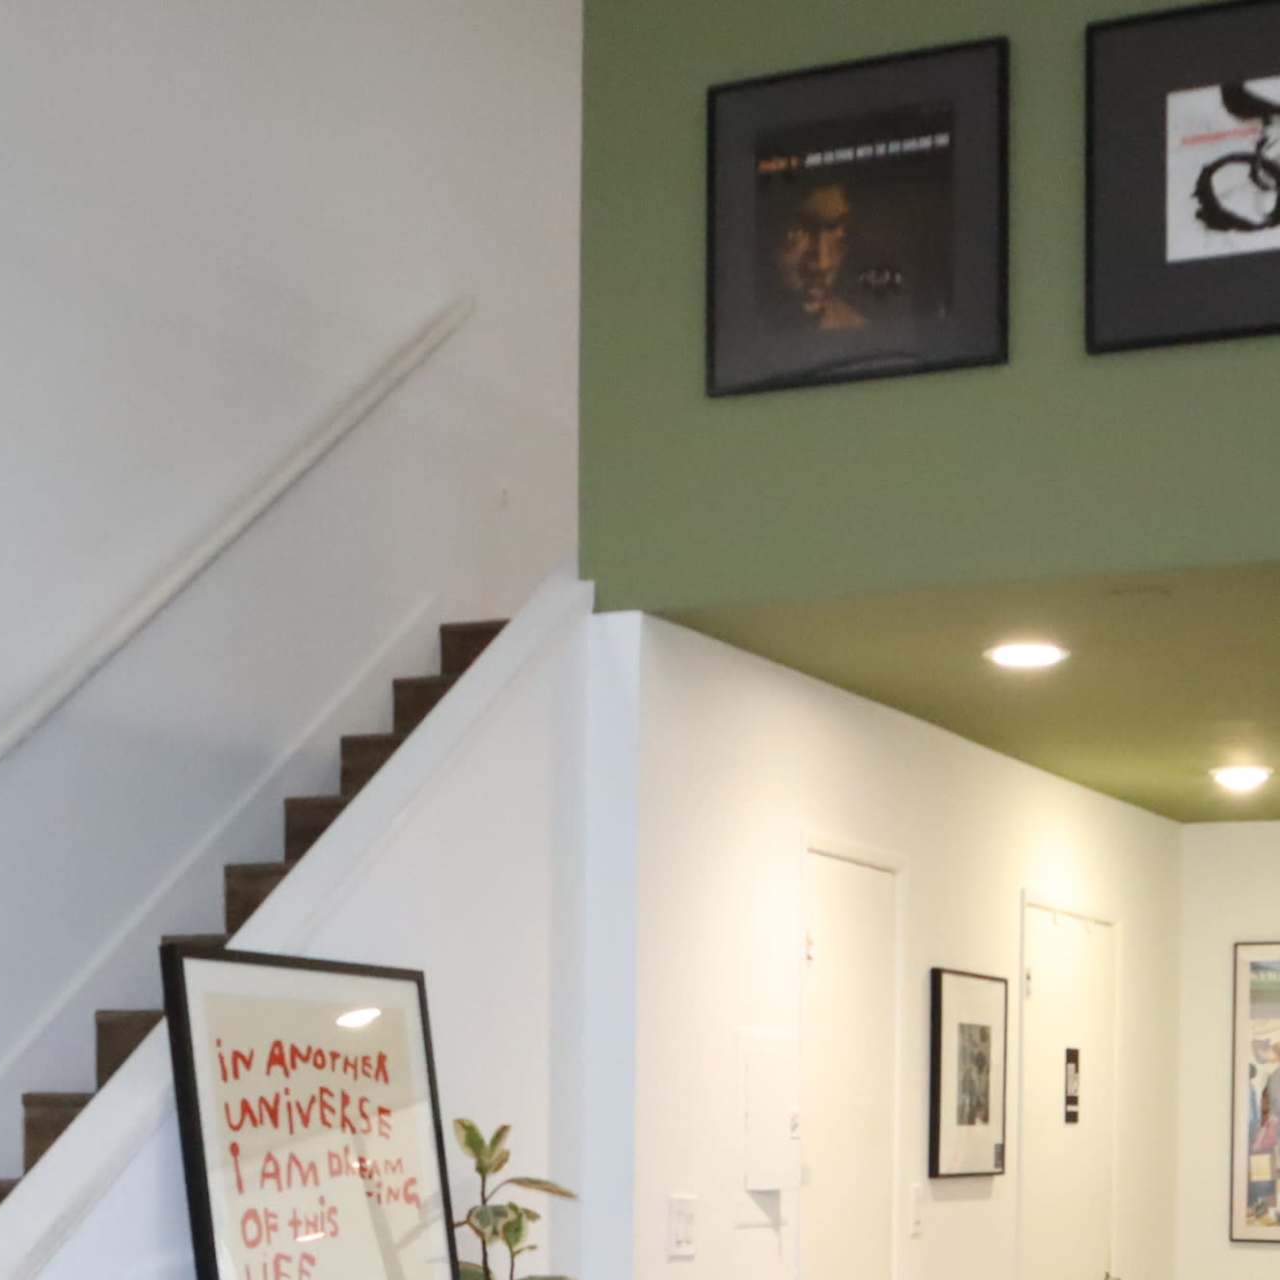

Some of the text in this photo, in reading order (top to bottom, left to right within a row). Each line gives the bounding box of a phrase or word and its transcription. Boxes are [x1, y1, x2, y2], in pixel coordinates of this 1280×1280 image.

[266, 1039, 390, 1085] ANOTHER
[260, 1151, 320, 1192] AM
[240, 1206, 279, 1249] OF
